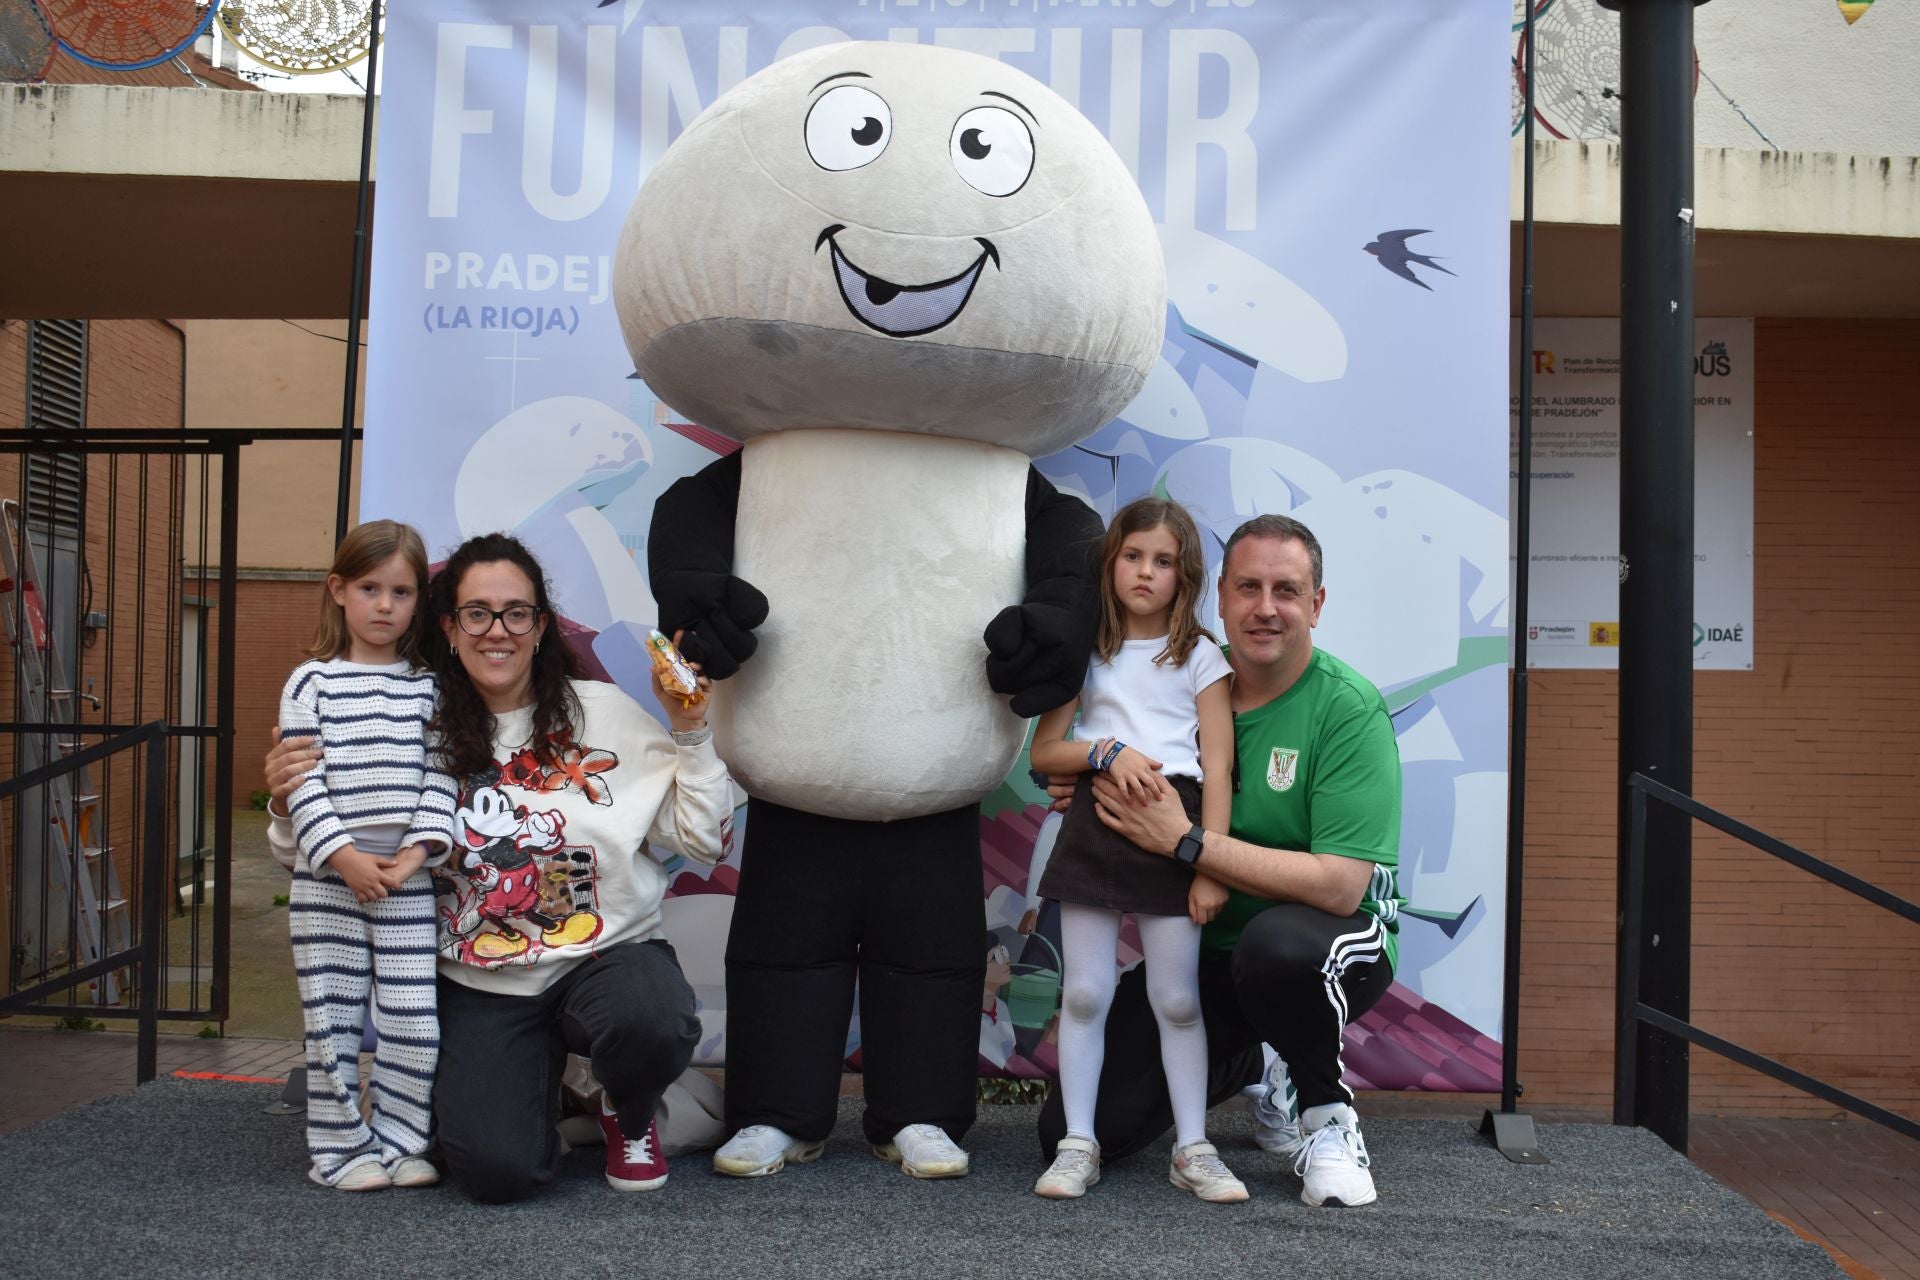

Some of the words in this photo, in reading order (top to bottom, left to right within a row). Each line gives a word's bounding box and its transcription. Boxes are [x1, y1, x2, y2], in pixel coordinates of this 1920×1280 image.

[423, 303, 473, 335] (LA
[480, 304, 580, 338] RIOJA)
[1563, 357, 1581, 365] Plan
[1583, 357, 1594, 365] de
[1694, 355, 1732, 377] US
[1551, 396, 1616, 406] ALUMBRADO
[1717, 396, 1732, 406] EN
[1538, 625, 1575, 634] Pradejón
